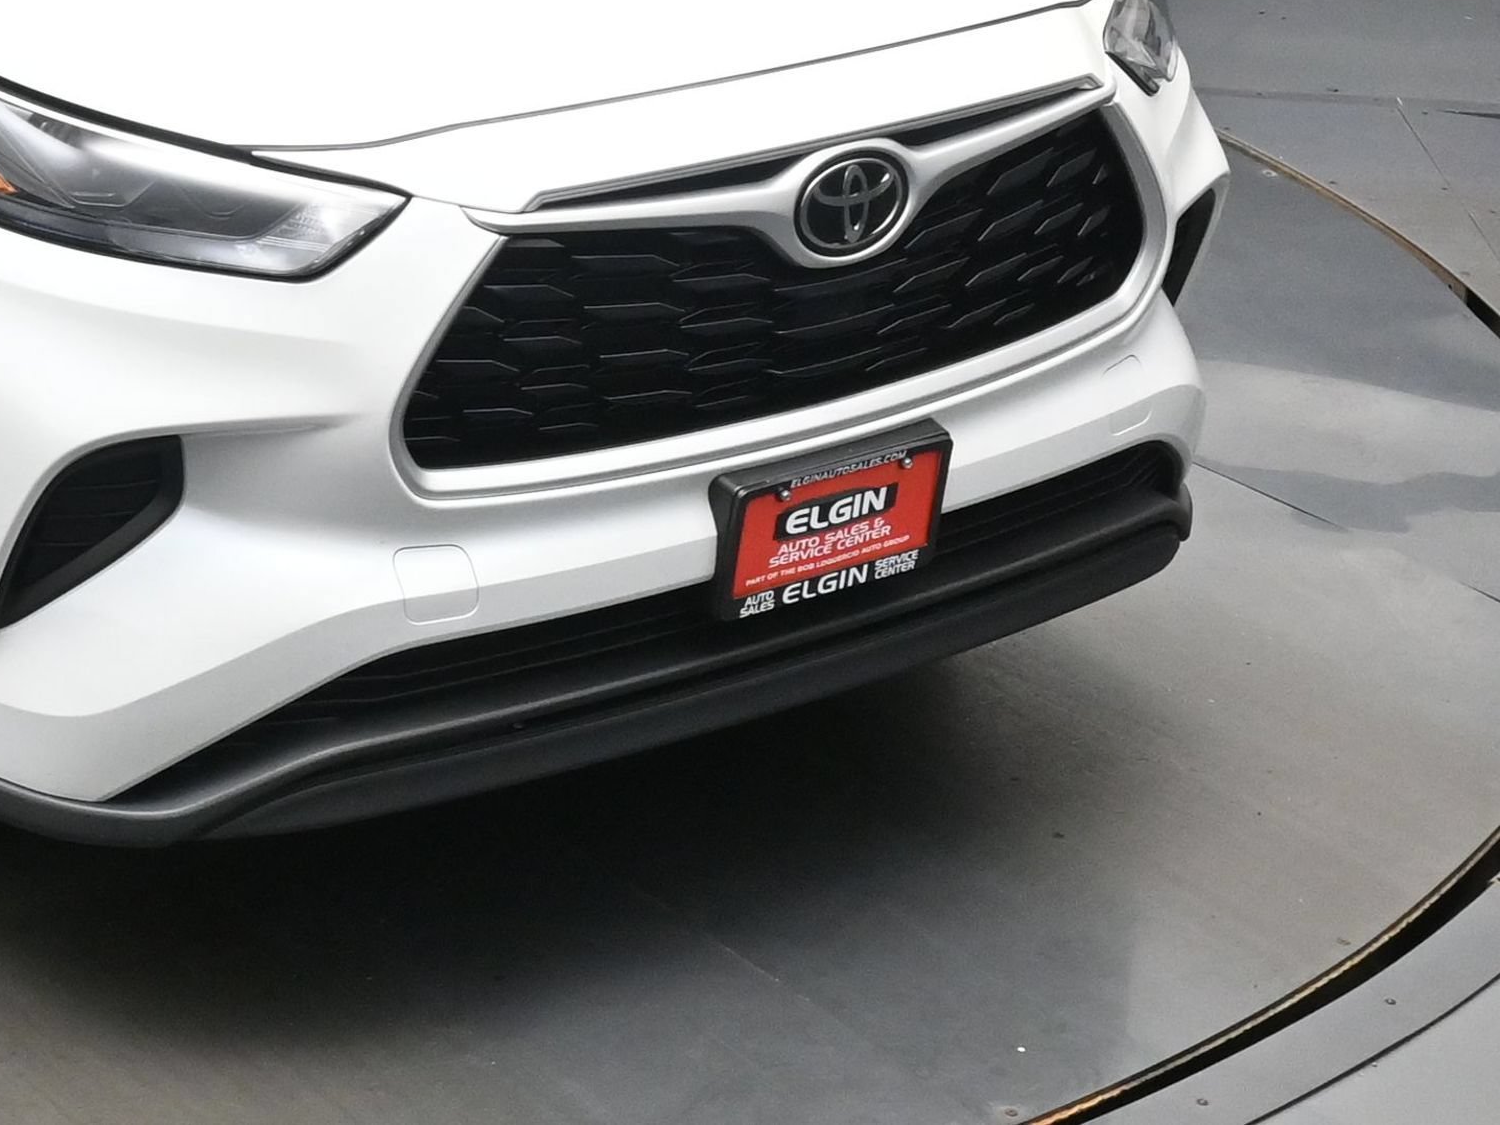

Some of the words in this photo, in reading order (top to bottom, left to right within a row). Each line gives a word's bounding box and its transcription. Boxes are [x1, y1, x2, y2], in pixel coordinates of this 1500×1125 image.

[790, 450, 907, 489] ELGINAUTOSALES.COM
[785, 486, 887, 535] ELGIN
[768, 544, 833, 569] SERVICE
[836, 526, 892, 551] CENTER
[777, 535, 820, 555] AUTO
[824, 521, 870, 545] SALES
[873, 517, 885, 529] &
[745, 574, 766, 587] PART
[766, 571, 779, 581] OF
[780, 567, 796, 577] THE
[797, 562, 816, 573] BOB
[861, 543, 882, 555] AUTO
[883, 535, 910, 548] GROUP
[874, 549, 920, 570] SERVICE
[874, 560, 917, 580] CENTER
[744, 589, 775, 608] AUTO
[782, 563, 869, 605] ELGIN
[739, 601, 775, 619] SALES
